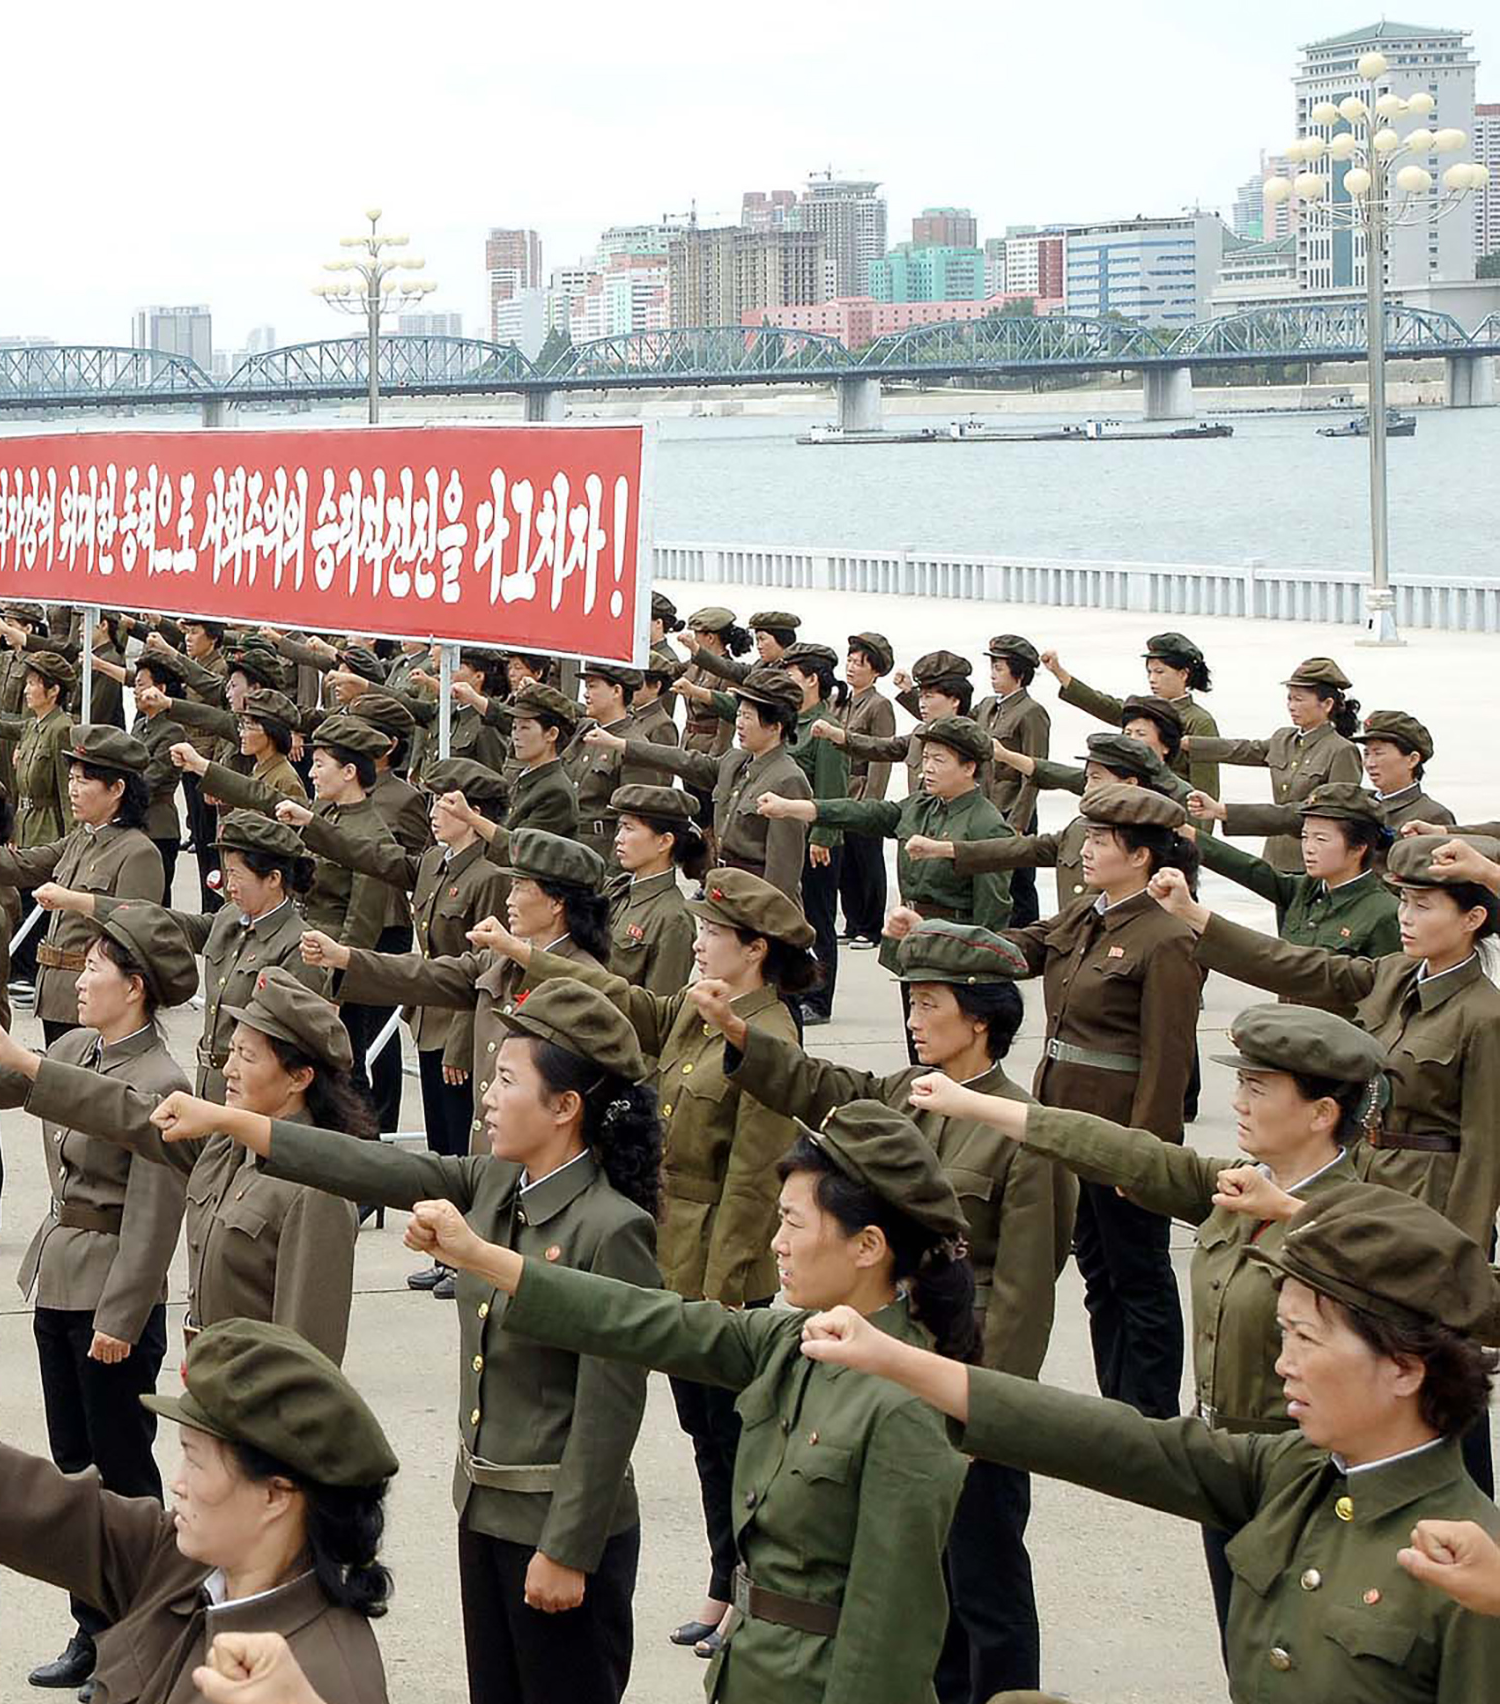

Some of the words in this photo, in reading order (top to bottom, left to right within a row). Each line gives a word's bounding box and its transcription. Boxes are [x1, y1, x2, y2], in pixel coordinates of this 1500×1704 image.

[57, 464, 118, 575] 위대한
[199, 466, 310, 591] 사회주의의
[473, 466, 629, 619] 다그치자!
